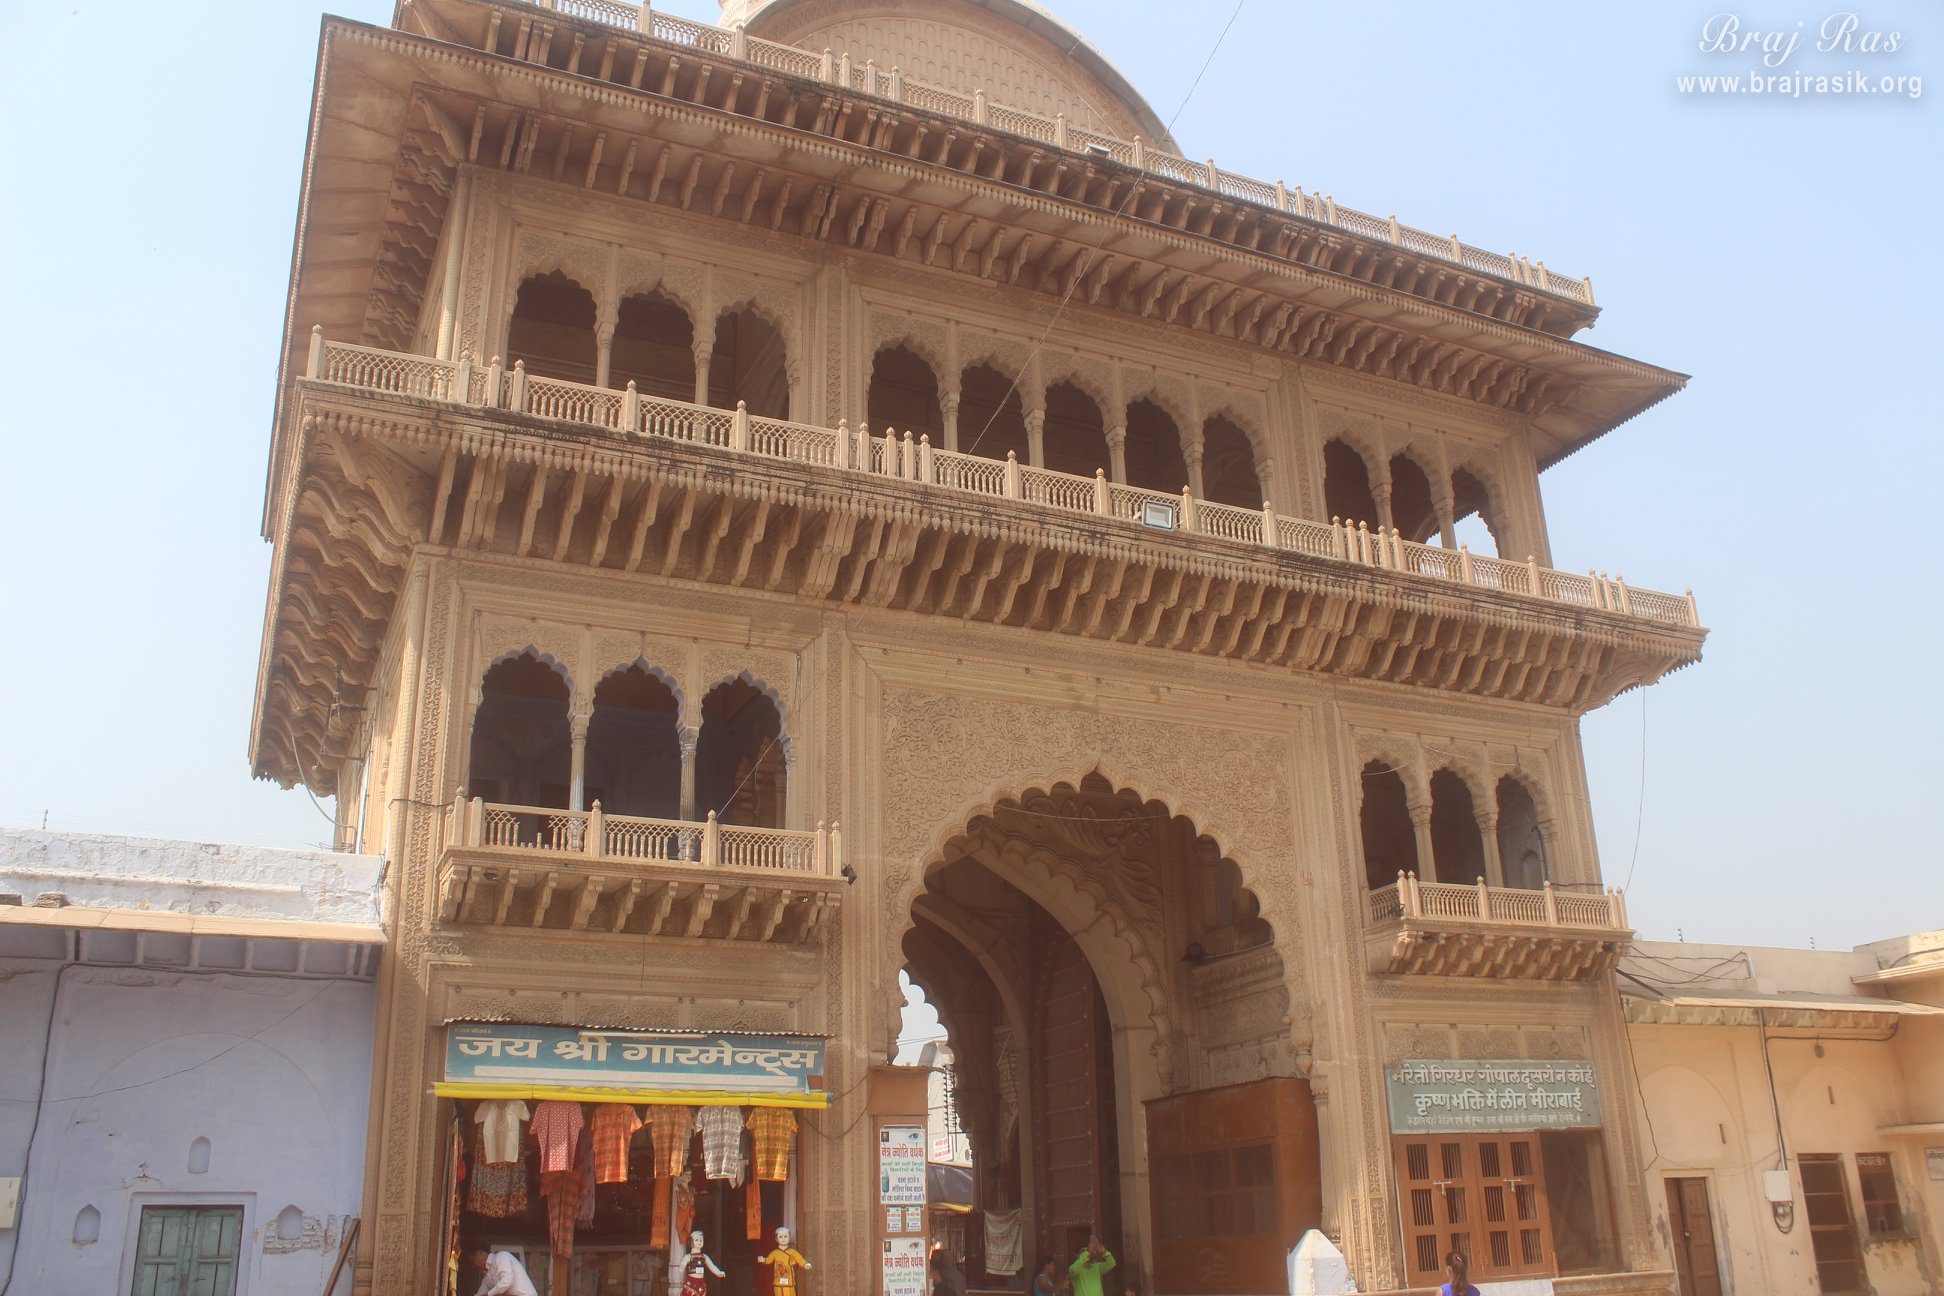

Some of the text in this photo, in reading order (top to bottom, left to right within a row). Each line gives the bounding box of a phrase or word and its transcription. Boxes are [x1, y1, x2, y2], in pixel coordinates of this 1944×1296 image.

[455, 1036, 542, 1059] जय
[553, 1036, 612, 1061] श्री
[622, 1039, 819, 1076] गारमेन्ट्स
[1392, 1063, 1414, 1084] मरे
[1430, 1065, 1475, 1085] गिरधर
[1477, 1064, 1521, 1084] गोपाल
[1556, 1069, 1566, 1083] न
[1567, 1065, 1595, 1088] कोई
[1413, 1087, 1583, 1115] कृष्ण भक्ति में लीन मीराबाई
[881, 1143, 891, 1158] नेत्र
[892, 1143, 908, 1158] ज्योति
[909, 1143, 924, 1158] वर्धक
[884, 1251, 924, 1268] नेत्र ज्योति वर्धक
